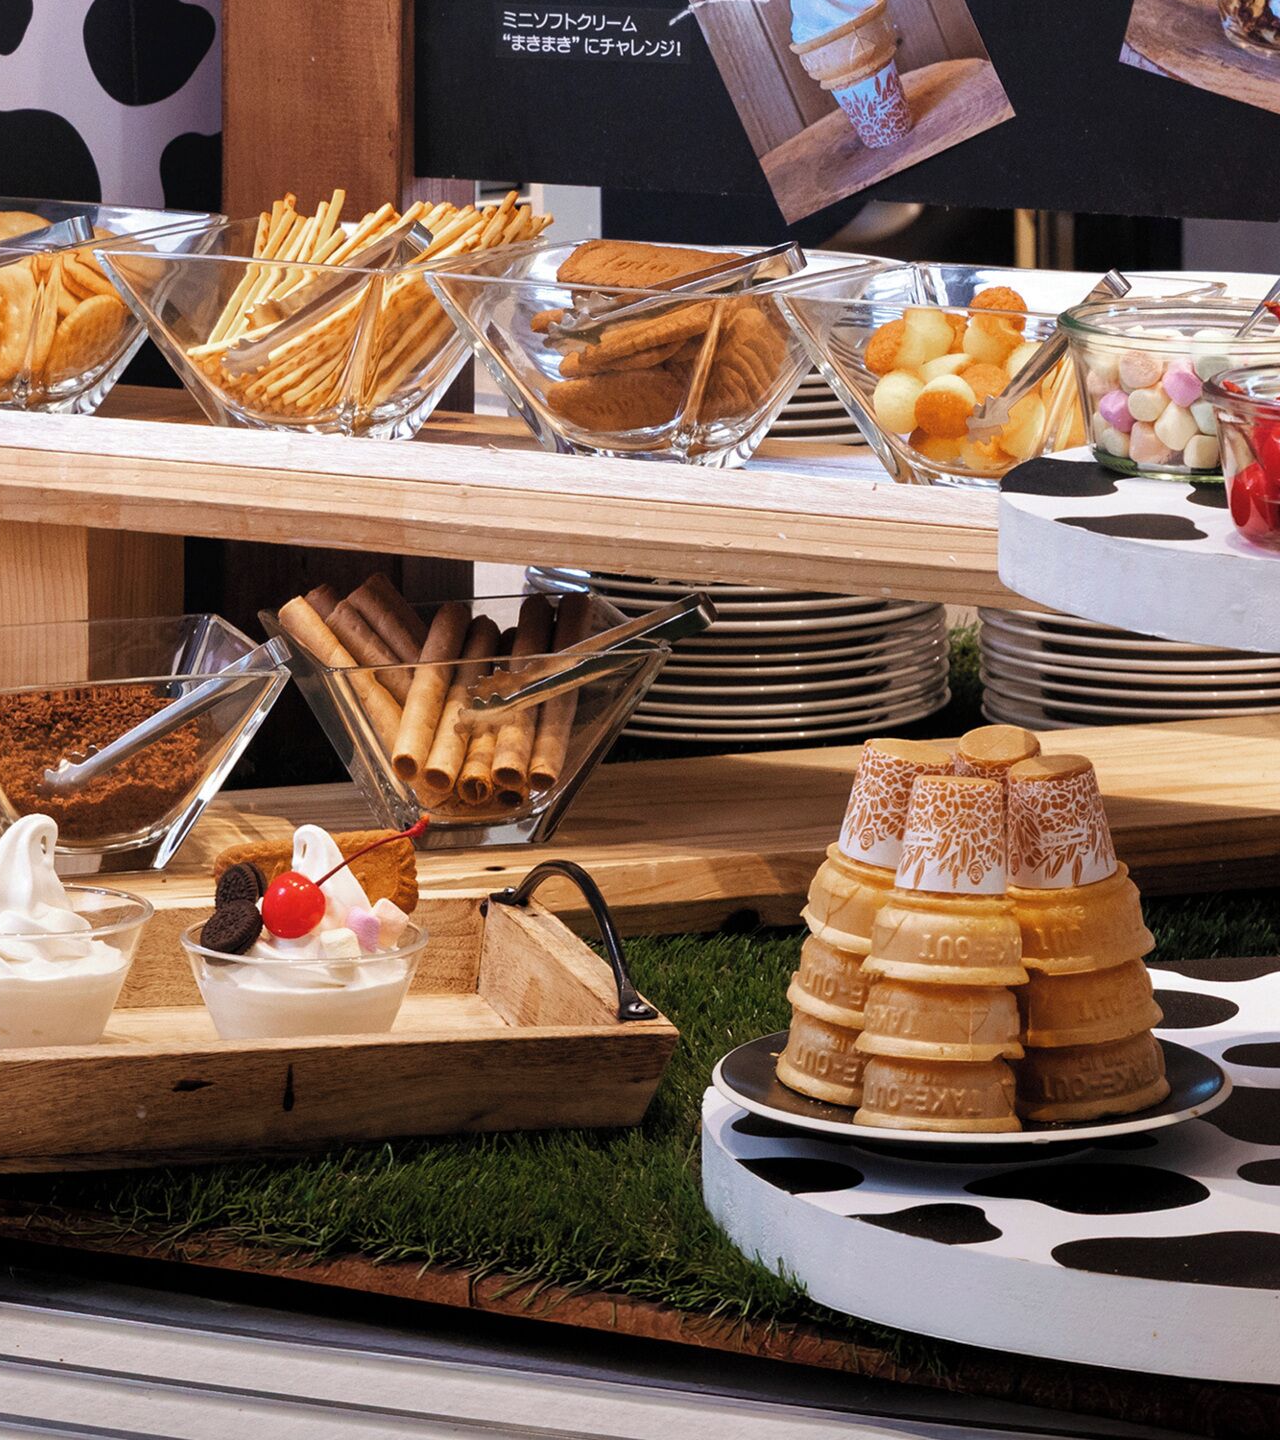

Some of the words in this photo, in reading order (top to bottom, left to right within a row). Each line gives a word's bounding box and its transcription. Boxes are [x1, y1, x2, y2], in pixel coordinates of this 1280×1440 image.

[503, 11, 638, 32] ミニソフトクリーム
